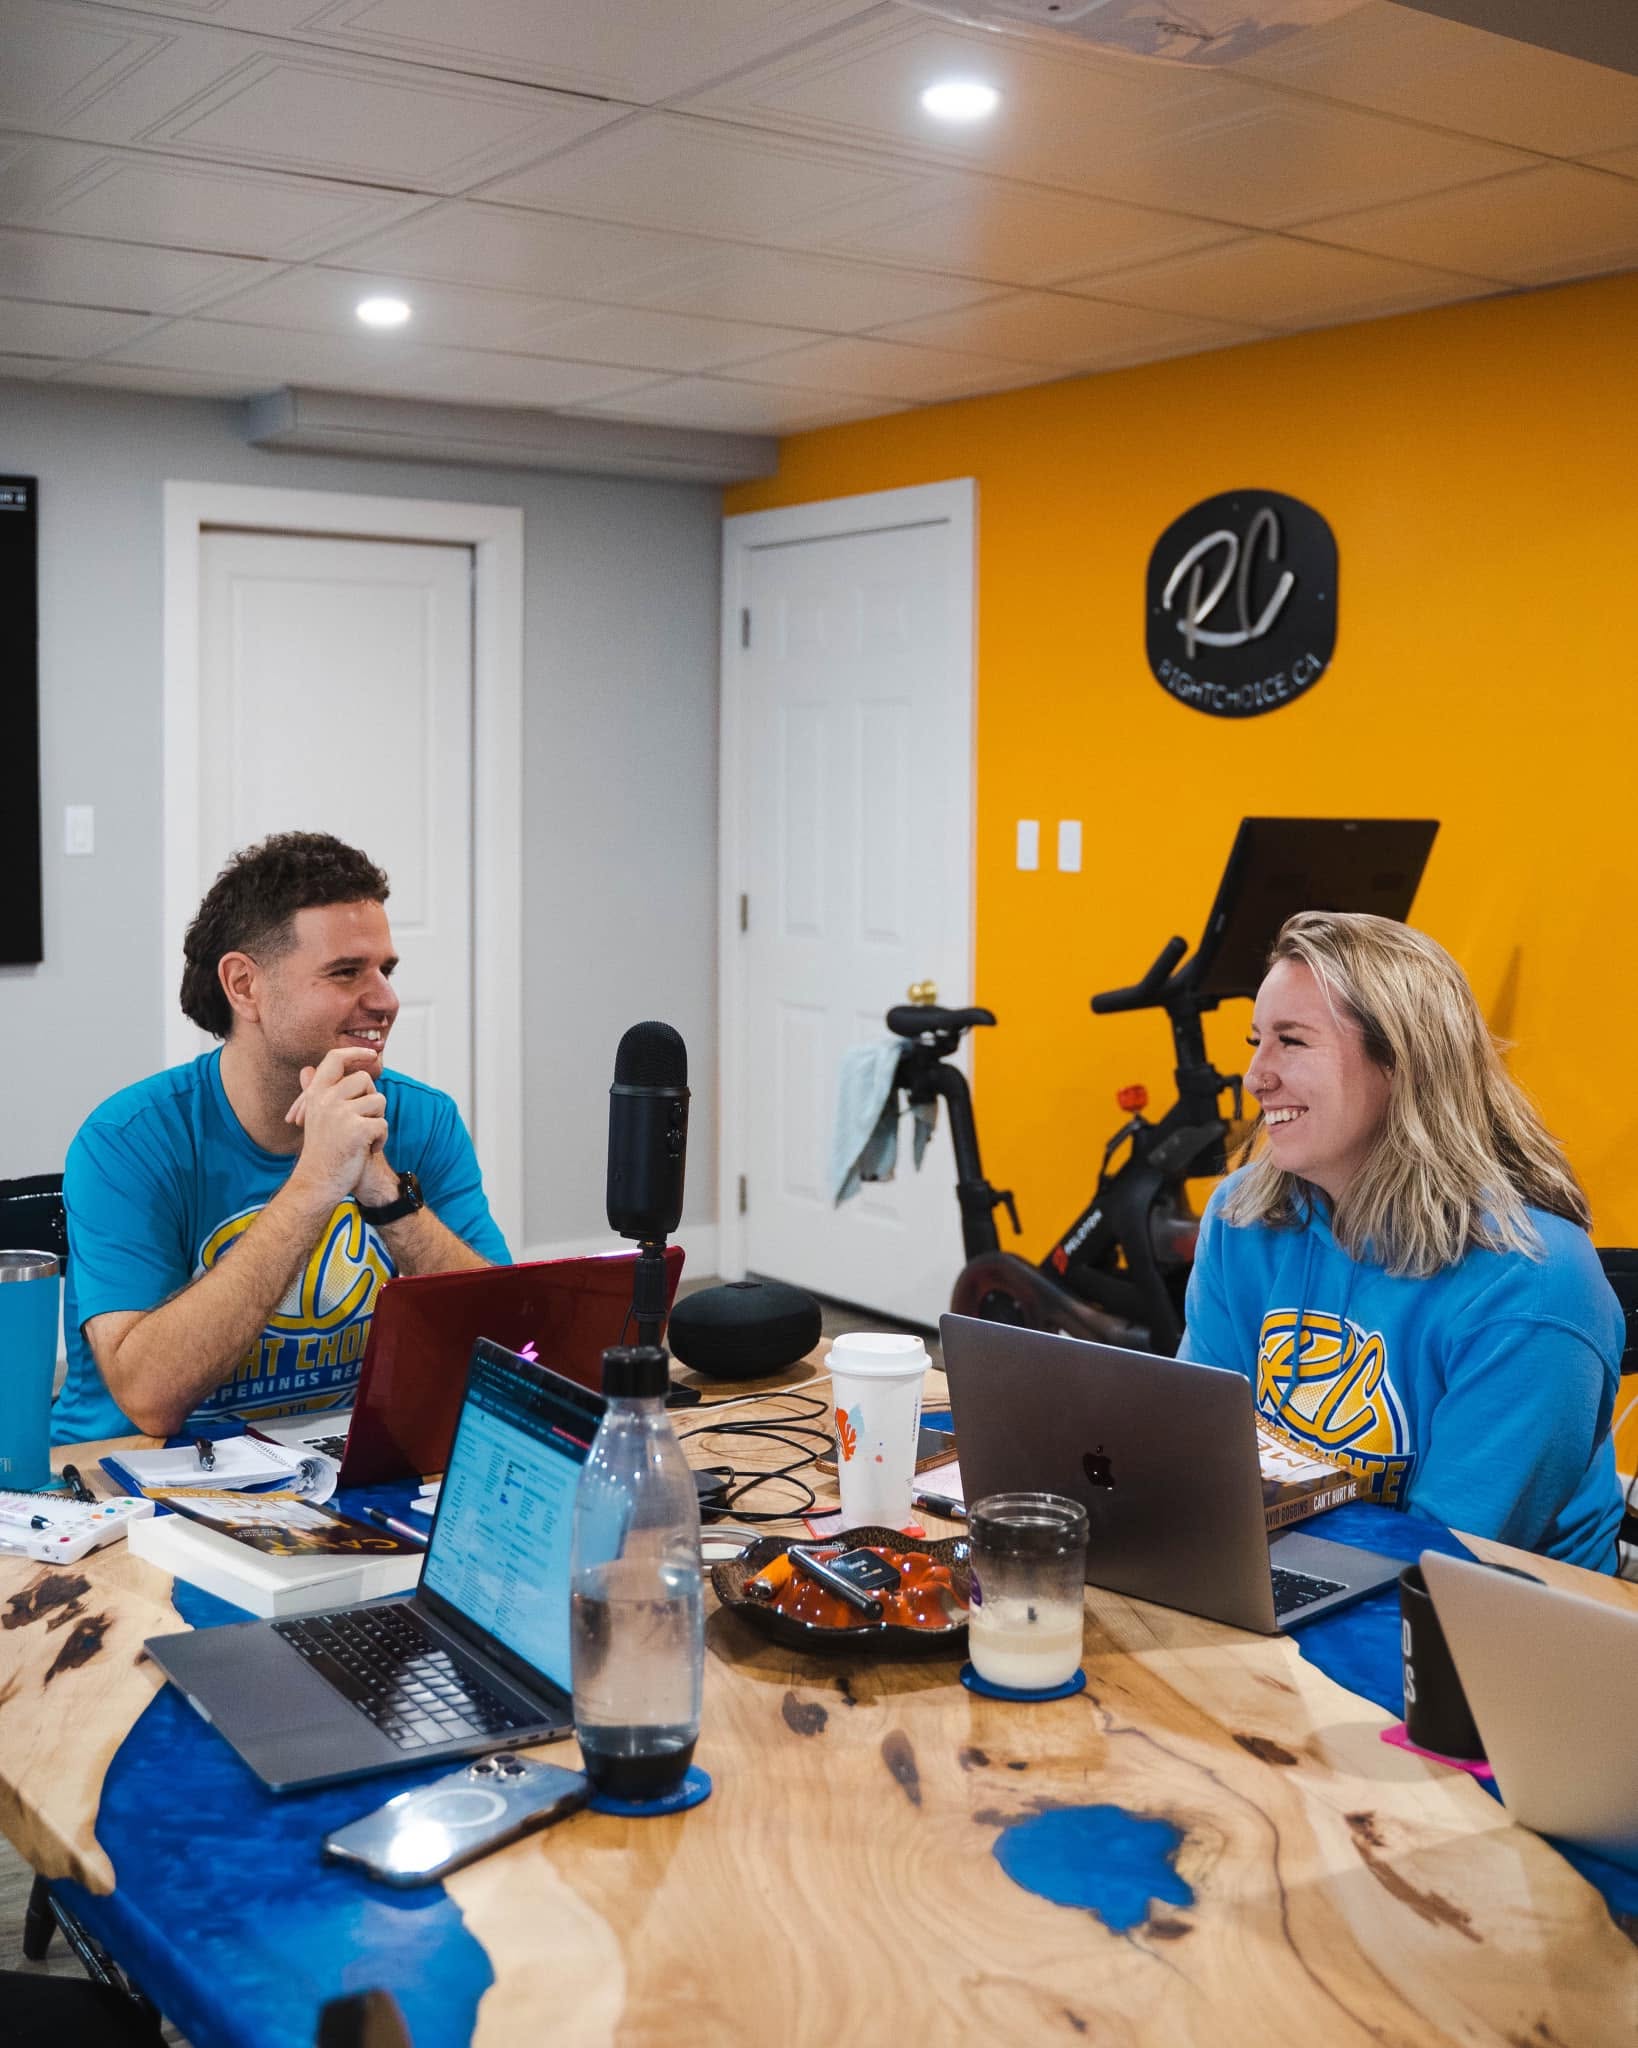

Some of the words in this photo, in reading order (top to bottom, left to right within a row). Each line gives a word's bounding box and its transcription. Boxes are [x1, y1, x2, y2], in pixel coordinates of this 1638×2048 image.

[1313, 1491, 1331, 1512] CAN'T
[1331, 1485, 1347, 1505] HURT
[1347, 1482, 1357, 1498] ME
